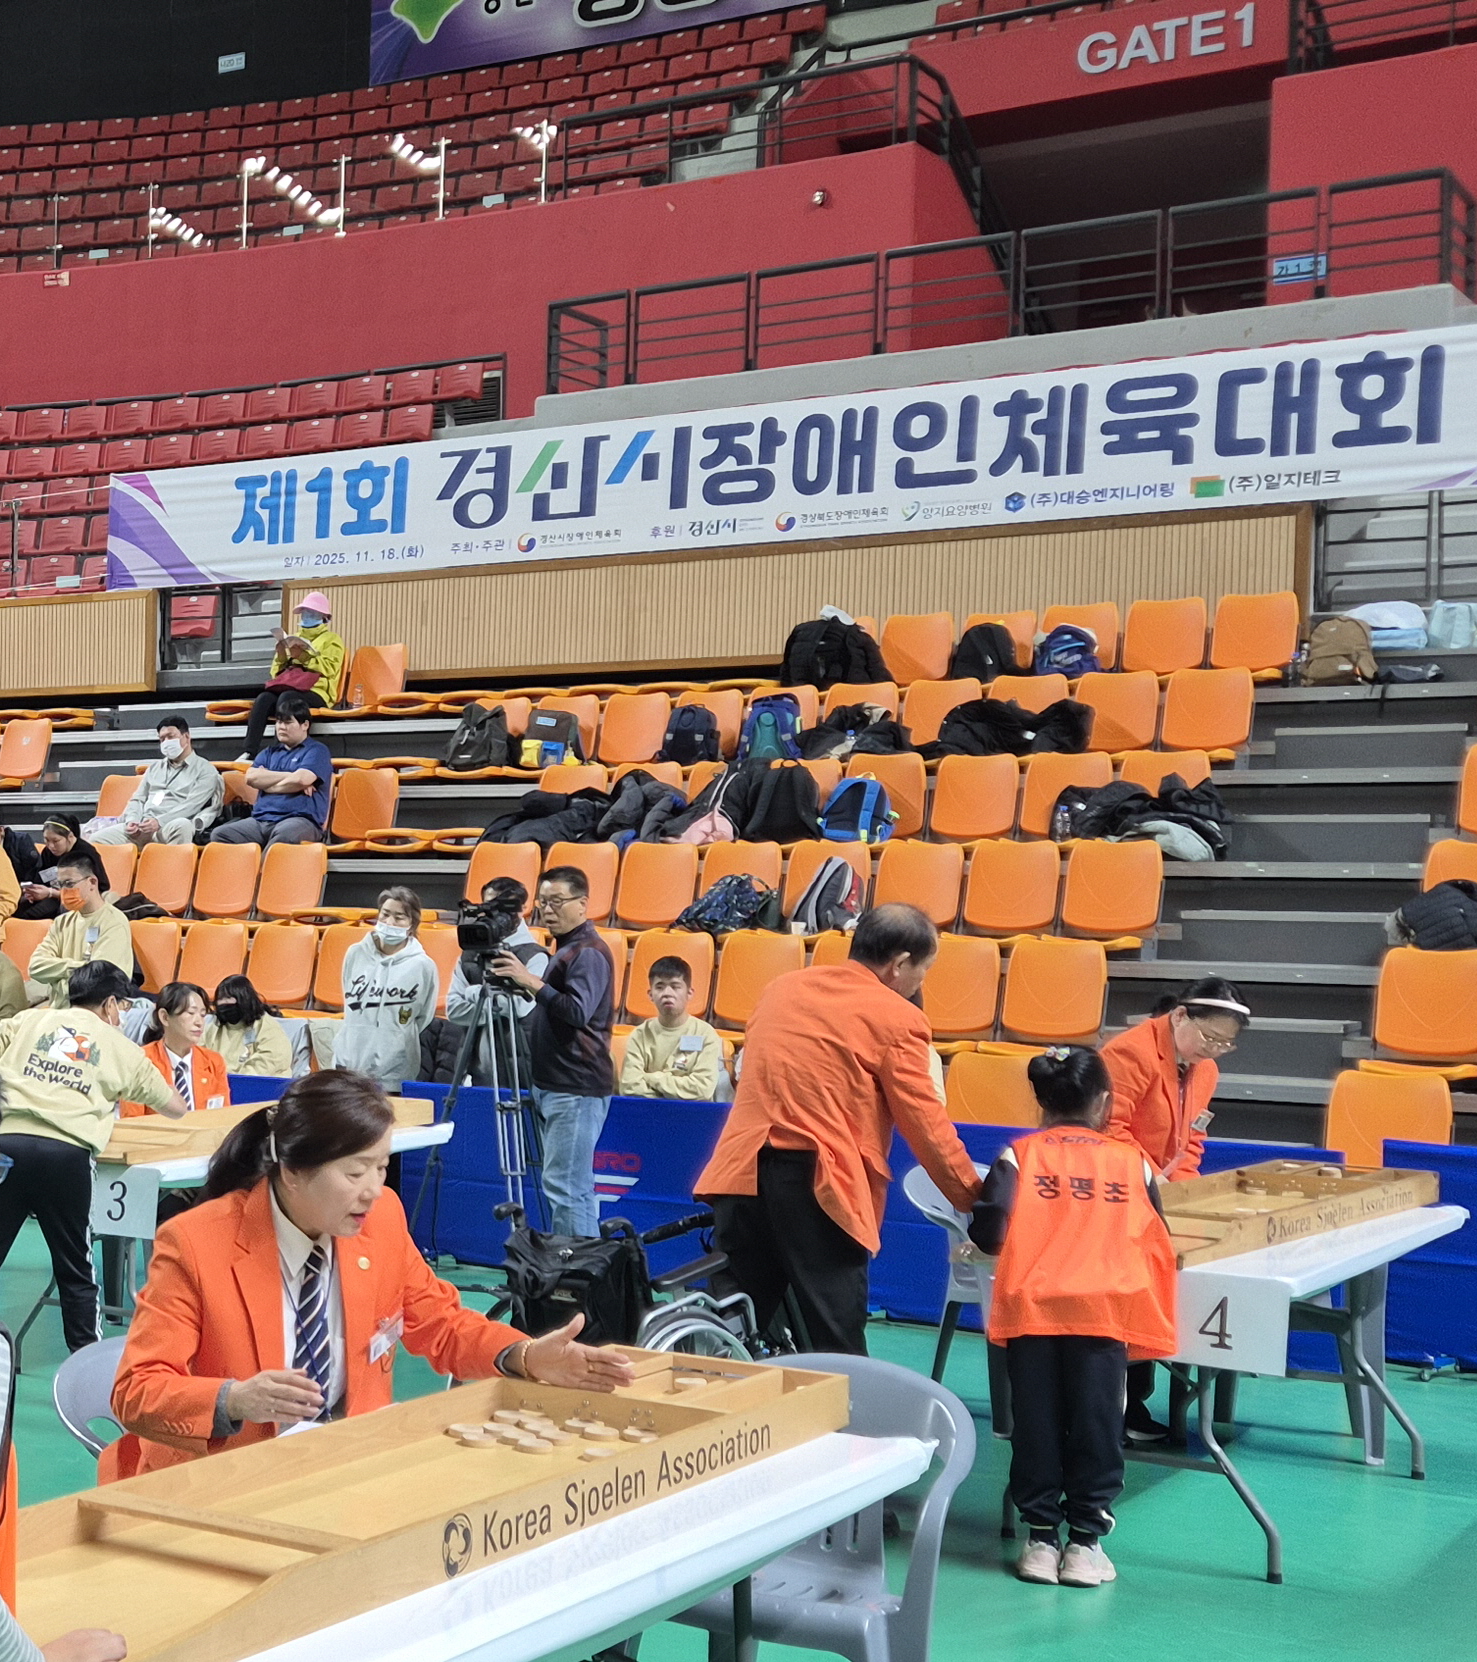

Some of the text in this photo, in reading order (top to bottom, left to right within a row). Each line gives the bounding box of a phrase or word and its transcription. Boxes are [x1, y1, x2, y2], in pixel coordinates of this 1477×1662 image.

[1077, 2, 1255, 74] GATE 1
[231, 344, 1445, 545] 제1회 경산시장애인체육대회
[1228, 469, 1341, 494] (주)일지테크
[649, 525, 675, 538] 후원
[314, 554, 349, 566] 2025.
[23, 1065, 92, 1096] the World
[27, 1053, 83, 1078] Explore
[106, 1180, 127, 1221] 3
[1279, 1188, 1414, 1238] Korea Sjoelen Association
[1199, 1296, 1233, 1350] 4
[483, 1422, 772, 1557] Korea Sjoelen Association
